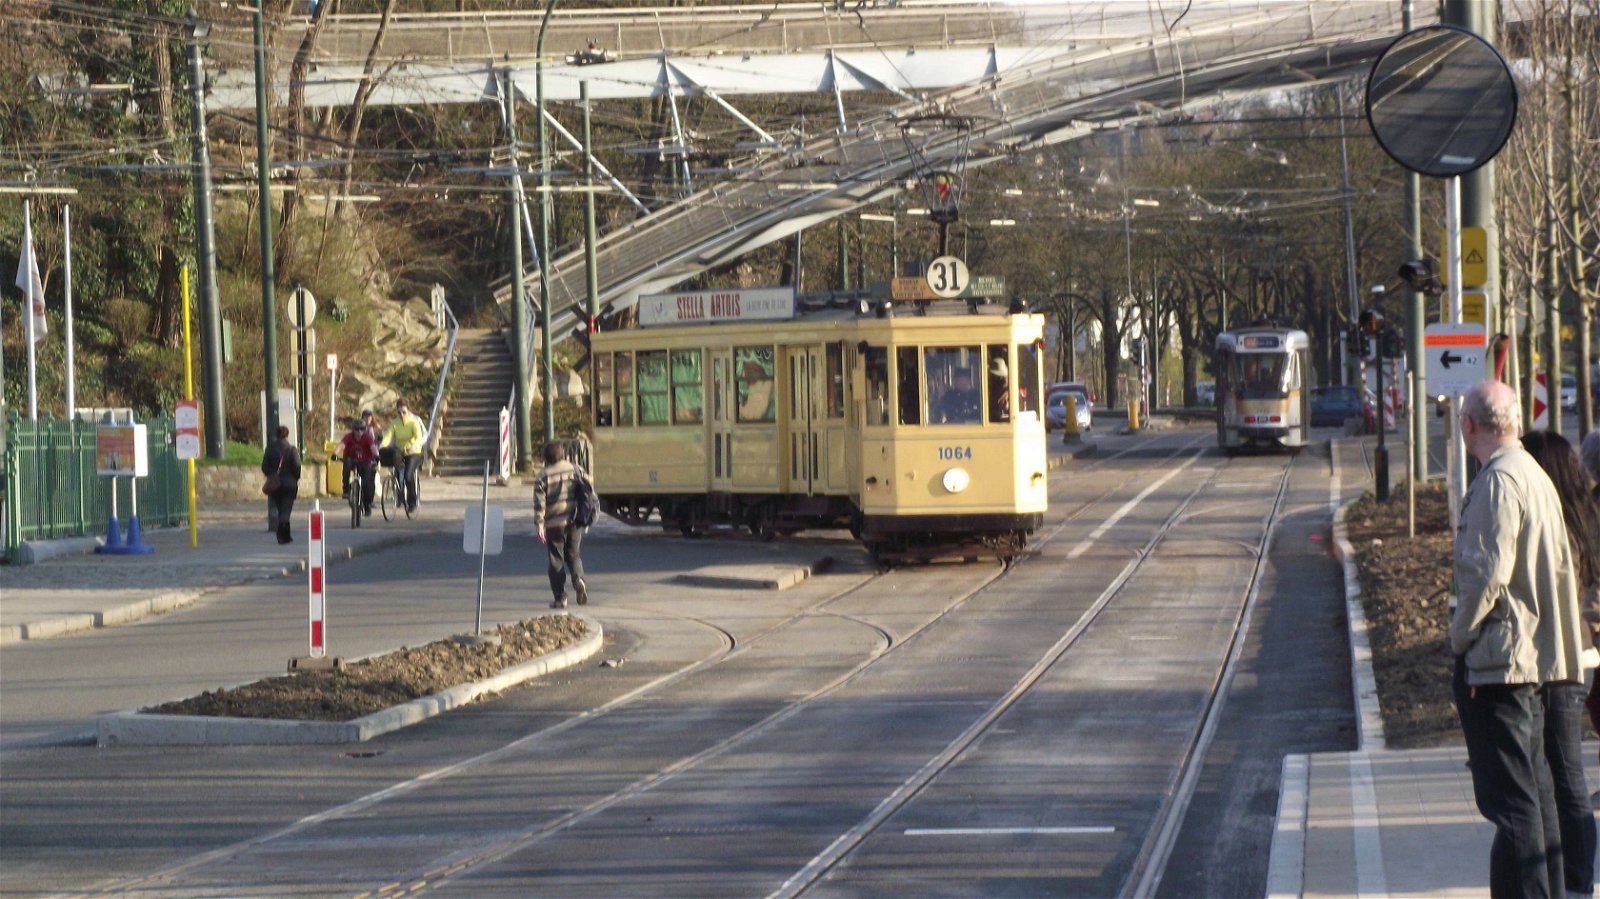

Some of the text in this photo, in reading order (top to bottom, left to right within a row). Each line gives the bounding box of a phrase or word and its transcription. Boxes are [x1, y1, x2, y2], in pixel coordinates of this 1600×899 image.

[932, 262, 961, 291] 31
[677, 295, 705, 320] STELLA
[710, 293, 741, 318] ARTOIS
[938, 446, 972, 460] 1064
